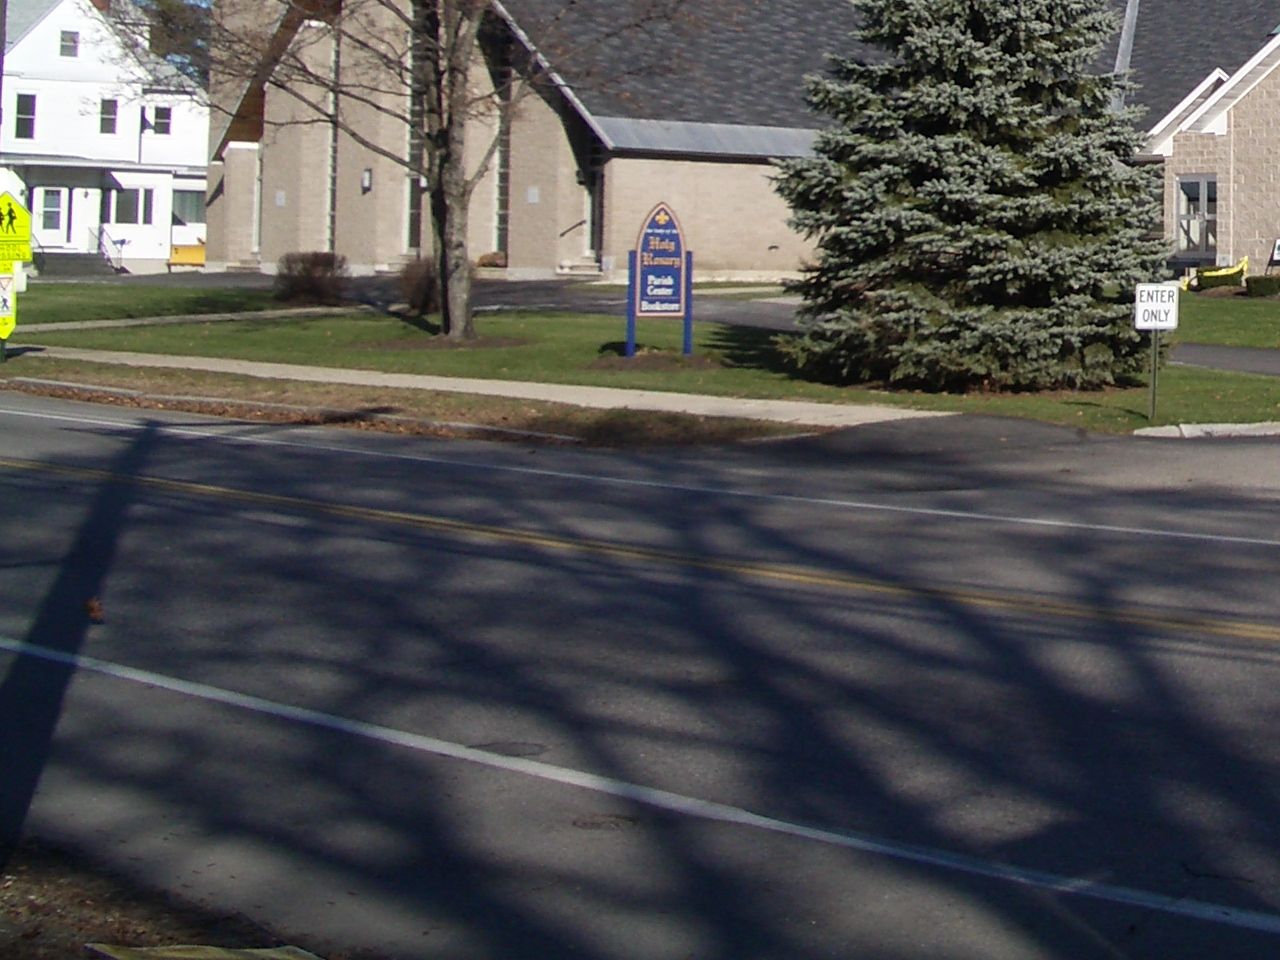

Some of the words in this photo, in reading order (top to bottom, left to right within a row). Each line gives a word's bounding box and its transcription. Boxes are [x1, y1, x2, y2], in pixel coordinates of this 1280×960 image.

[647, 275, 674, 285] Parish
[646, 285, 673, 295] Center
[1139, 289, 1175, 303] ENTER
[641, 300, 680, 311] Bookstore
[1142, 309, 1170, 323] ONLY
